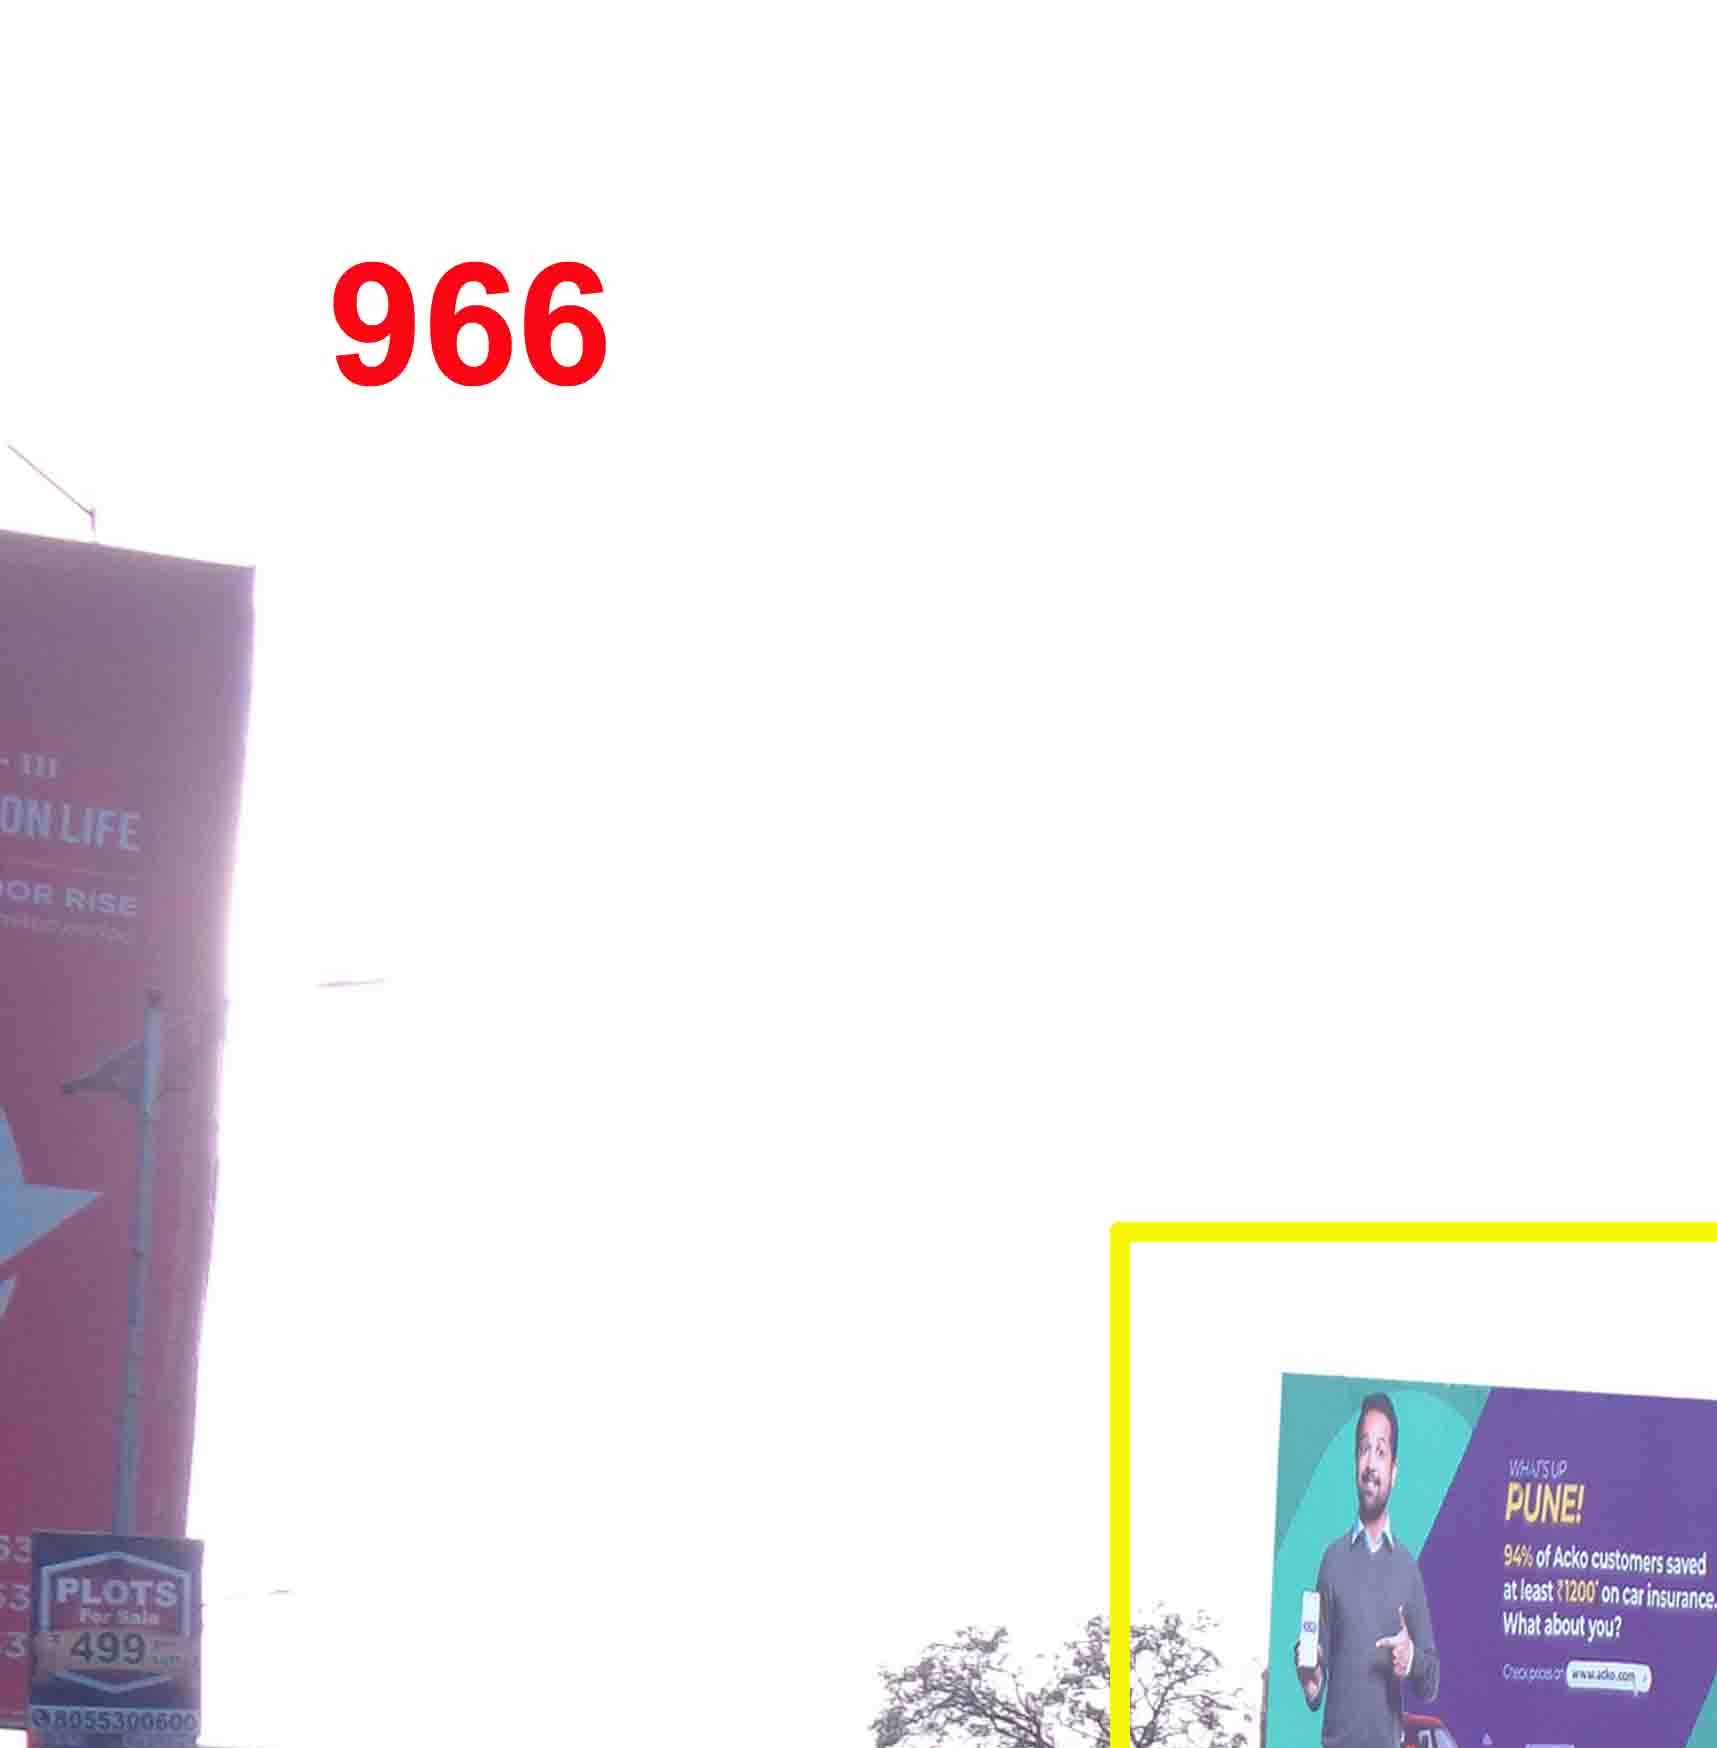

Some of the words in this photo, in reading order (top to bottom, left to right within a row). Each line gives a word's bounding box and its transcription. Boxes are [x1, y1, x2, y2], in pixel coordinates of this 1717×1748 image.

[63, 801, 142, 852] LIFE
[0, 879, 54, 906] OR
[63, 886, 138, 917] RISE
[1552, 1460, 1569, 1480] UP
[1504, 1481, 1586, 1525] PUNE!
[1503, 1543, 1534, 1567] 94%
[1535, 1545, 1552, 1569] of
[1553, 1544, 1589, 1570] Acko
[1591, 1548, 1664, 1574] customers
[1665, 1551, 1708, 1577] saved
[55, 1577, 178, 1608] PLOTS
[1503, 1580, 1518, 1601] at
[1520, 1578, 1554, 1602] least
[1601, 1586, 1620, 1604] on
[1622, 1586, 1644, 1605] car
[1503, 1611, 1541, 1636] What
[1544, 1612, 1586, 1638] about
[1588, 1615, 1623, 1643] you?
[69, 1631, 146, 1665] 499
